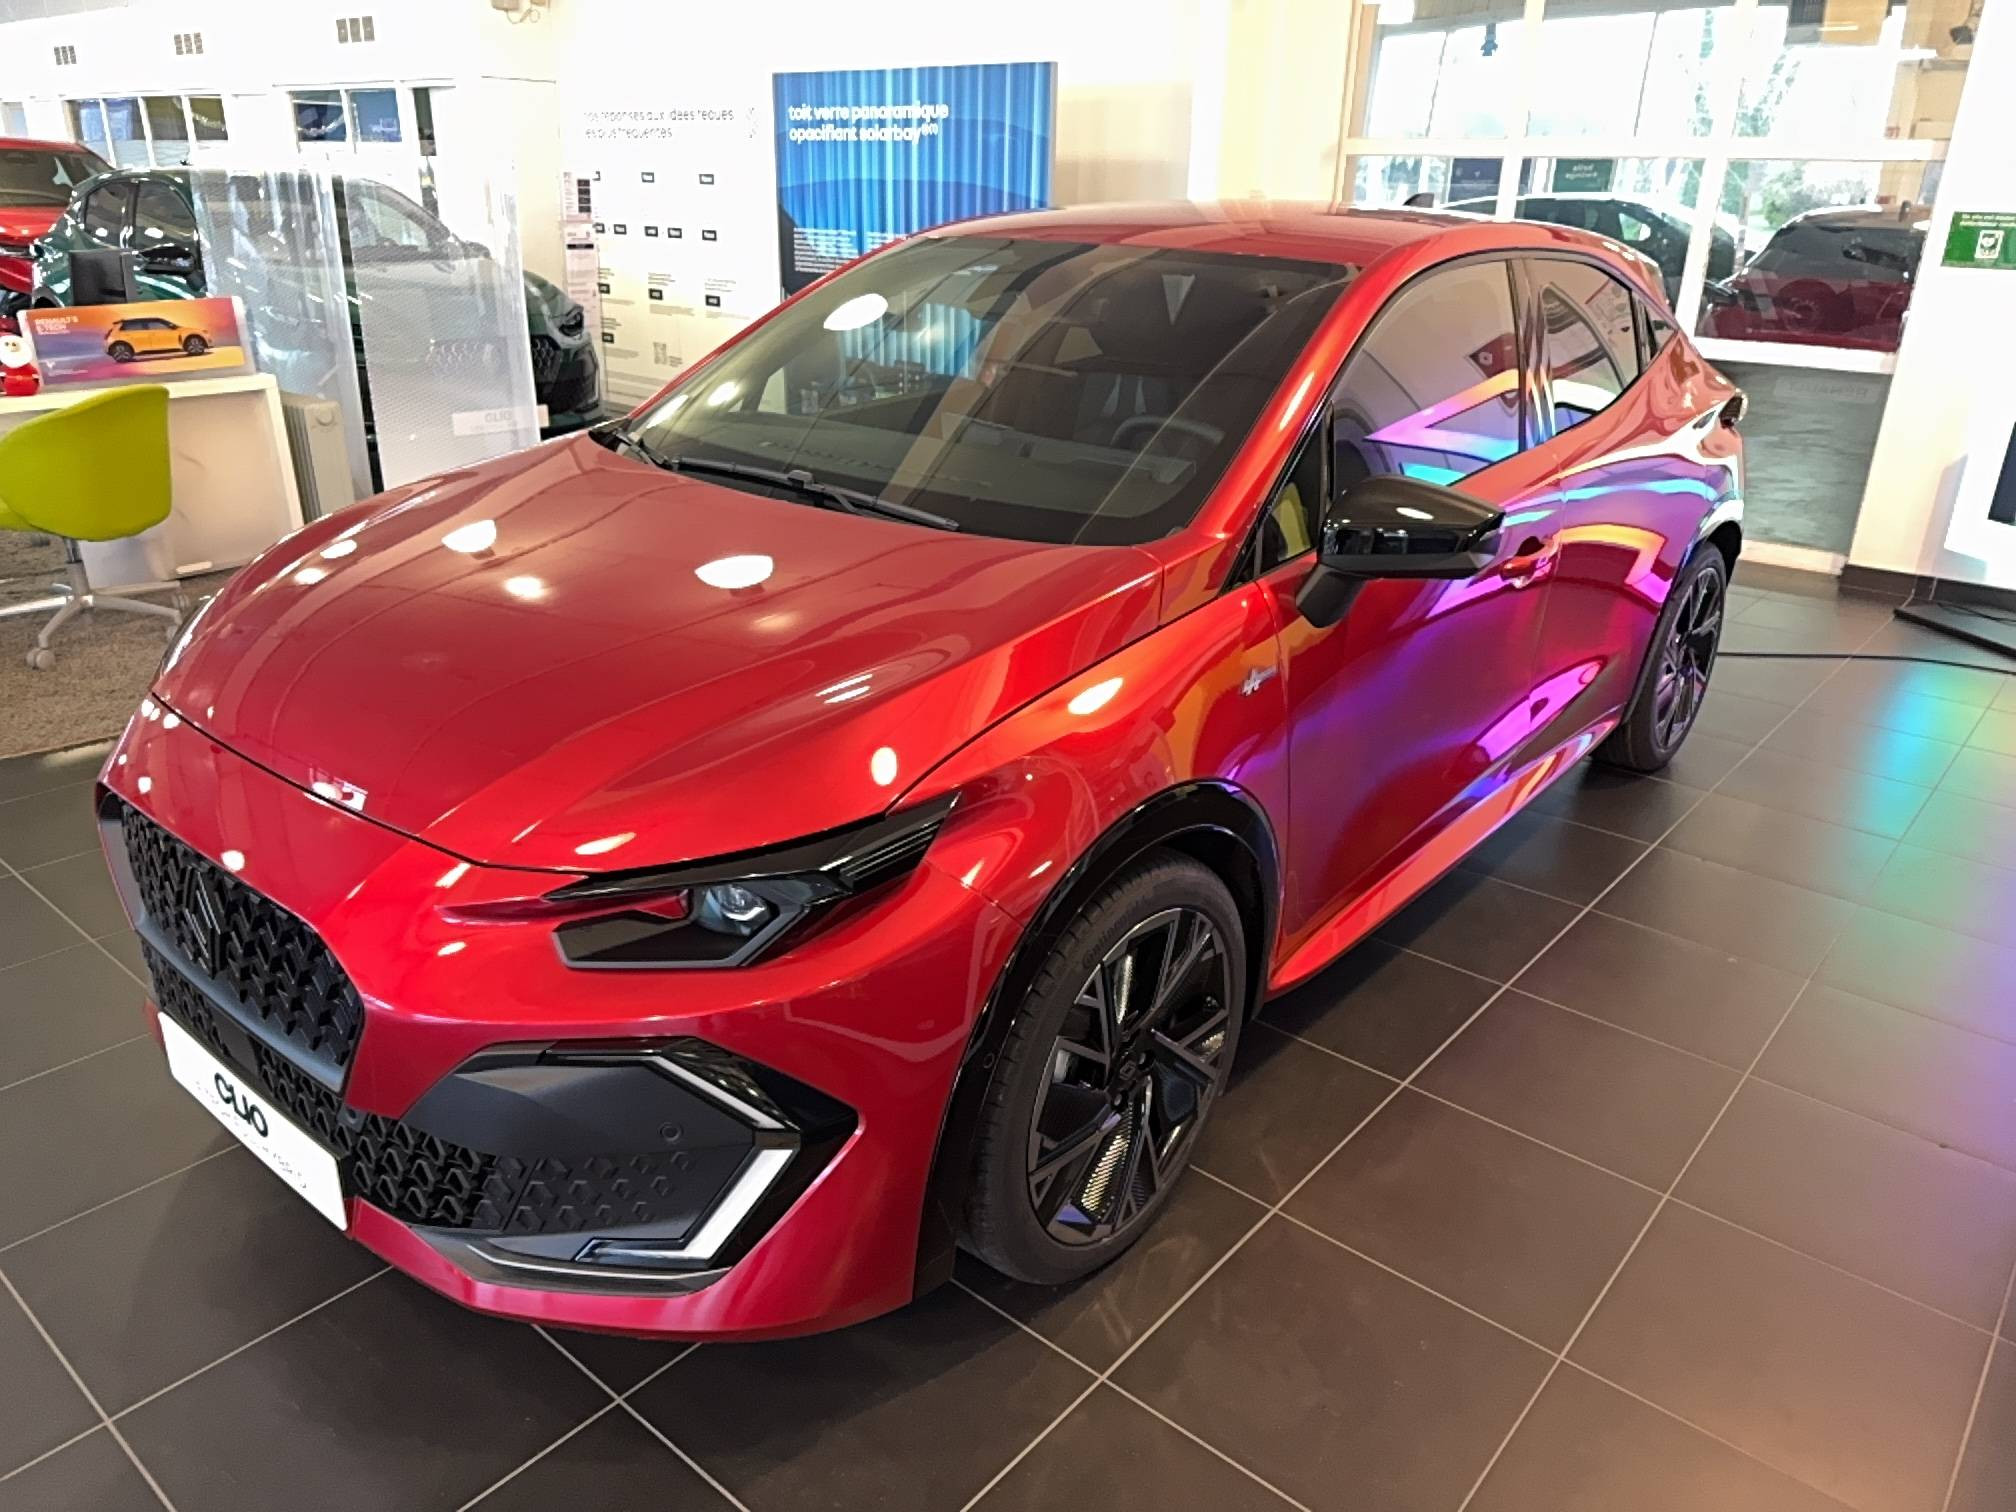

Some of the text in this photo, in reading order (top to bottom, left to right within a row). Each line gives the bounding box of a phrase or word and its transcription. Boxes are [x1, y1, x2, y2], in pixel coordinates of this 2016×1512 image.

[788, 101, 949, 123] toit verre panoramique
[788, 123, 857, 144] opacifiant
[214, 1072, 269, 1138] CLIO
